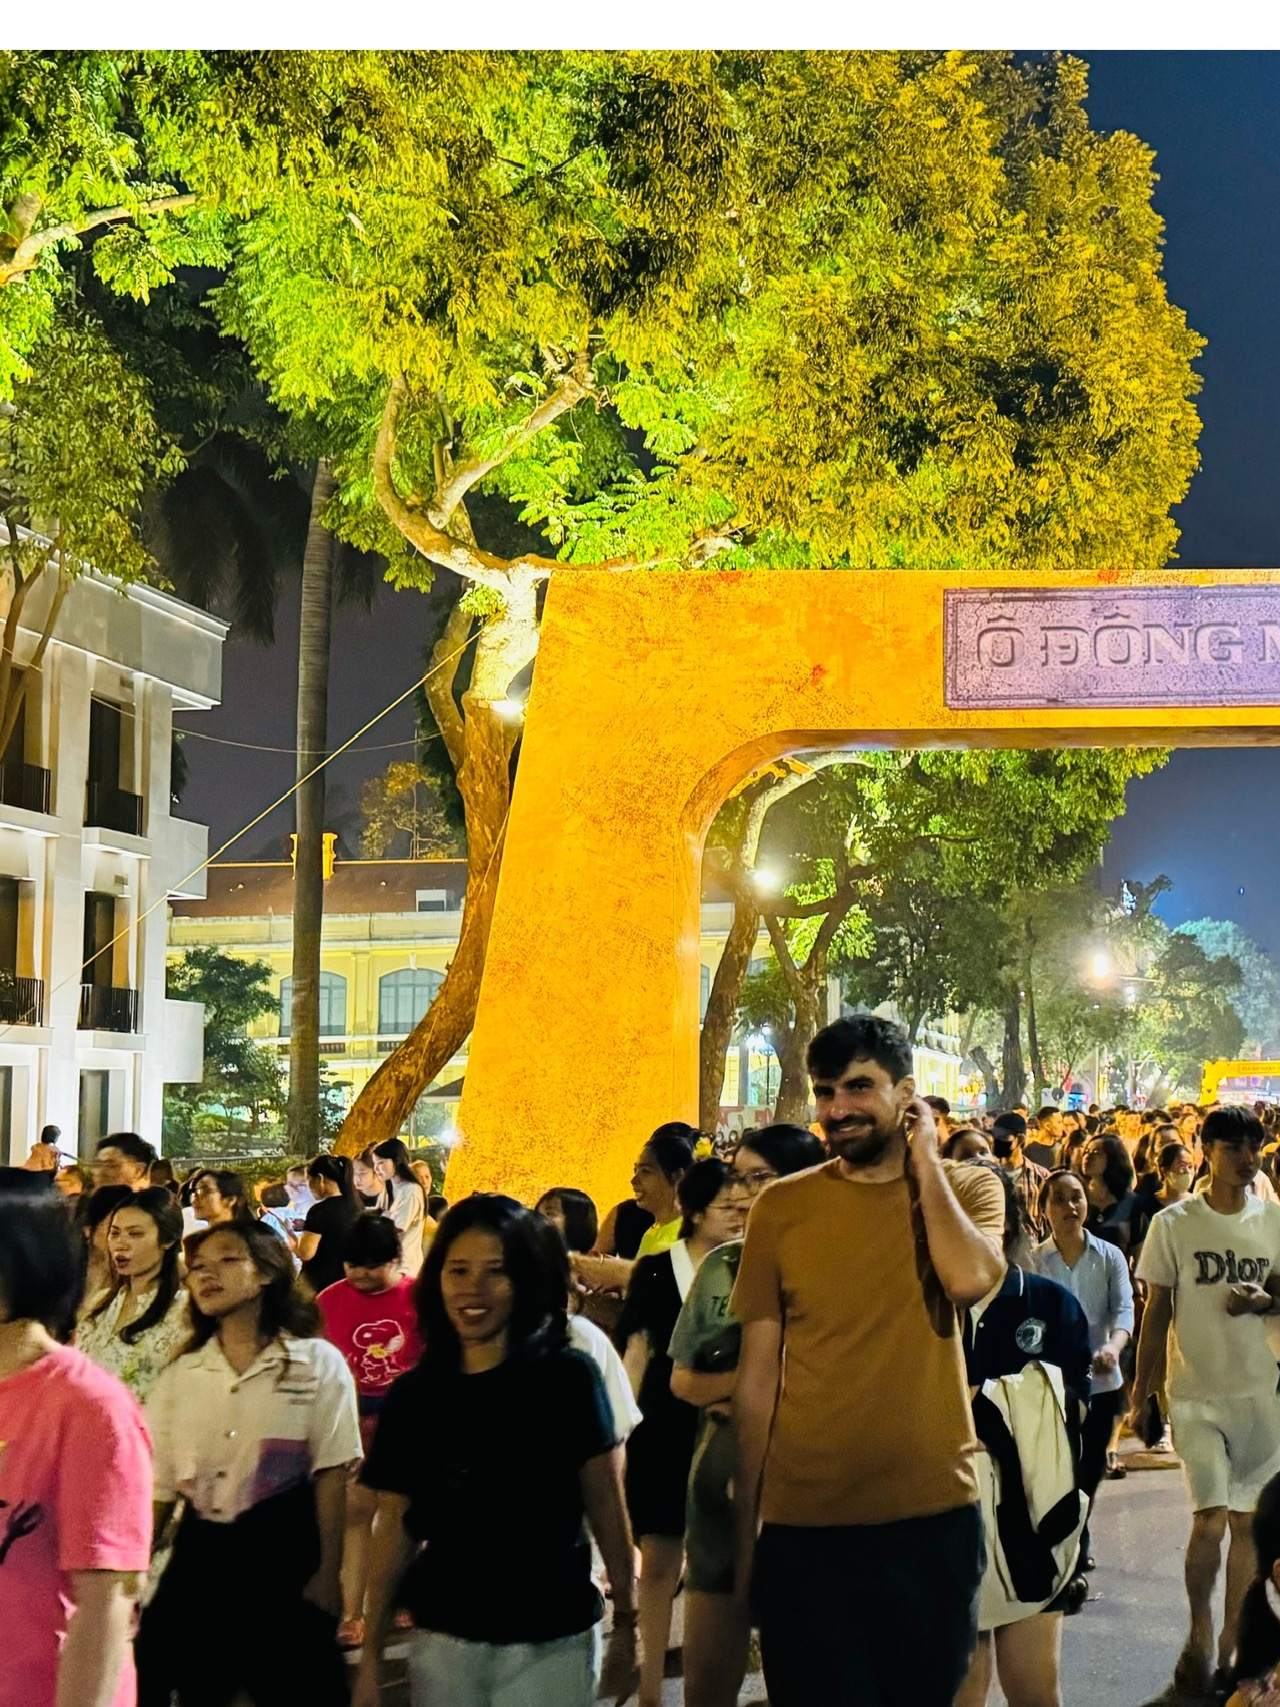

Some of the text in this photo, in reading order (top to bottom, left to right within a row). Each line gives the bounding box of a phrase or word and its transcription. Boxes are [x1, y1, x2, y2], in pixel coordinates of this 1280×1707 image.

[977, 614, 1024, 669] Ô
[1040, 612, 1245, 668] ĐÔNG
[1194, 1249, 1269, 1285] Dior
